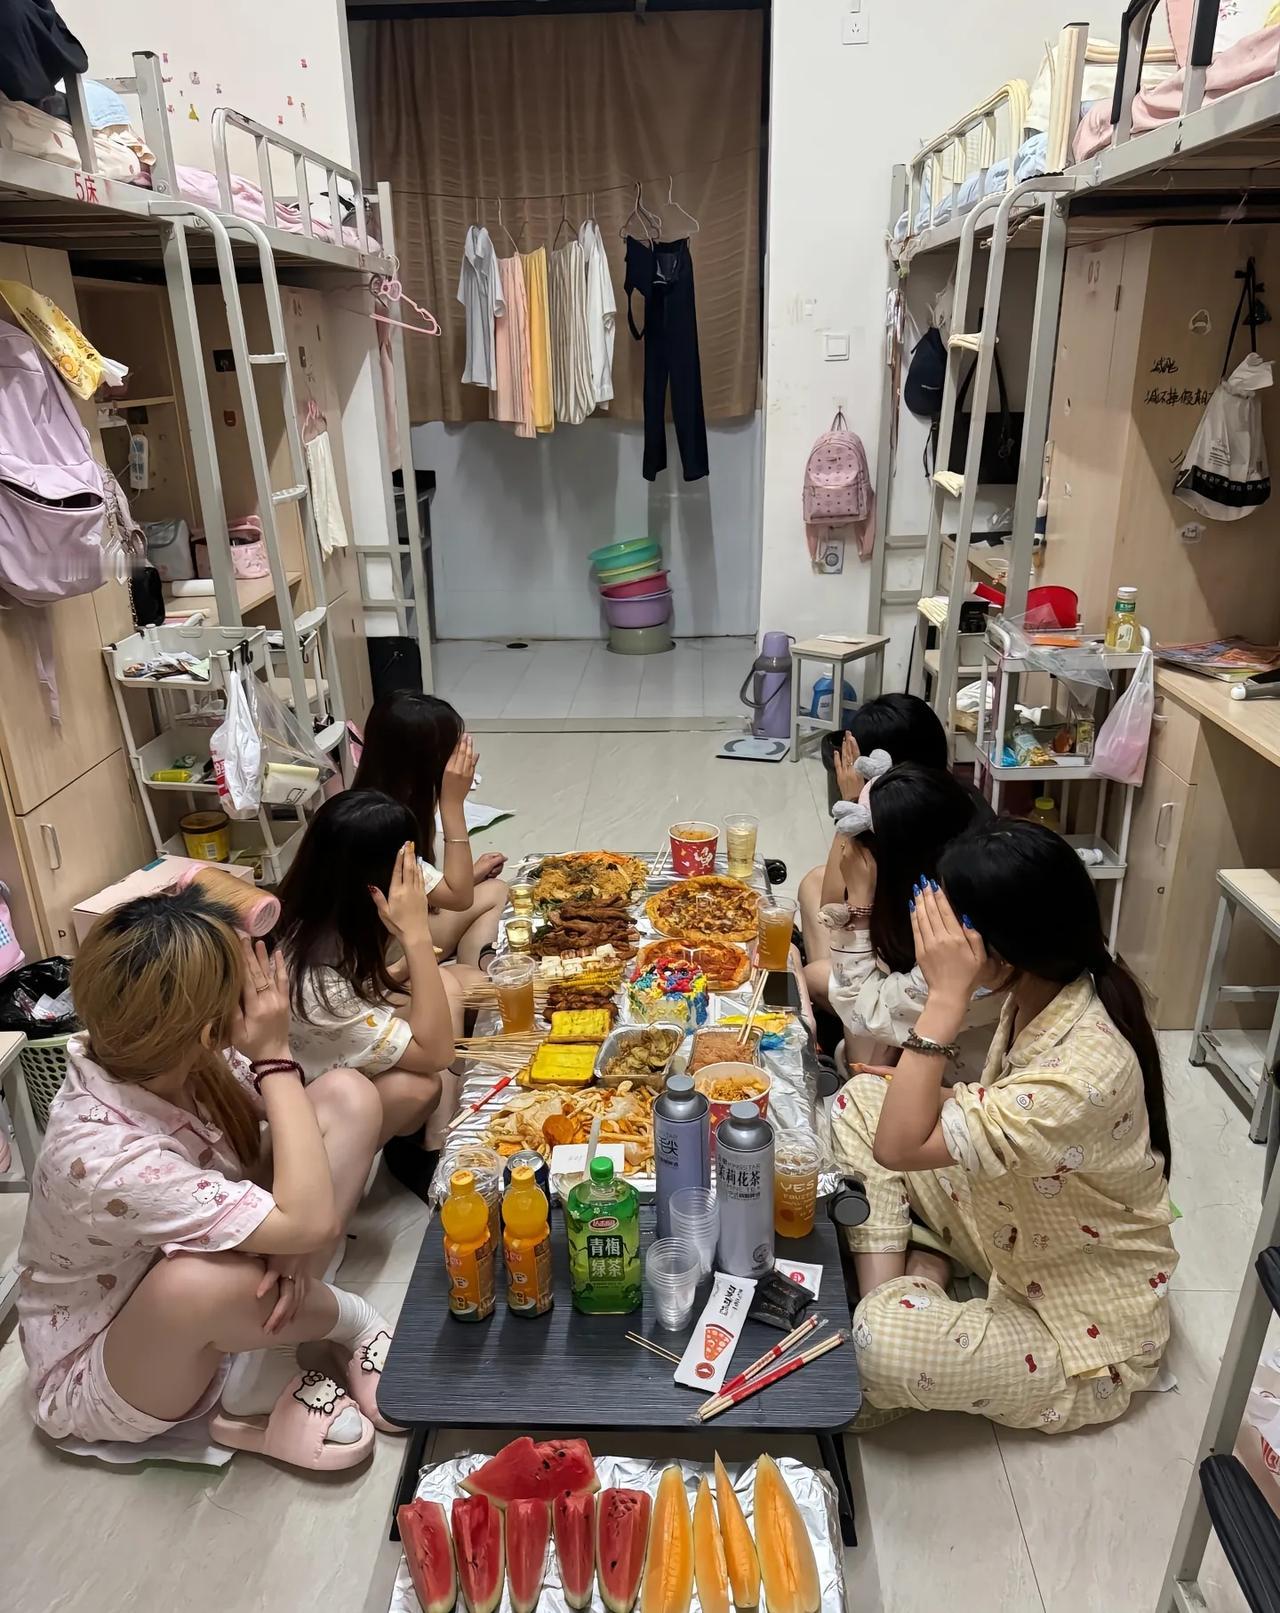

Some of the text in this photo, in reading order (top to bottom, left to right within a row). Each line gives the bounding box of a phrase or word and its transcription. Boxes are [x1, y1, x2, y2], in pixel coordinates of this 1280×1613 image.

[718, 1163, 760, 1187] 茉莉花茶
[780, 1180, 815, 1193] YES
[590, 1237, 621, 1256] 青梅
[592, 1259, 622, 1277] 绿茶
